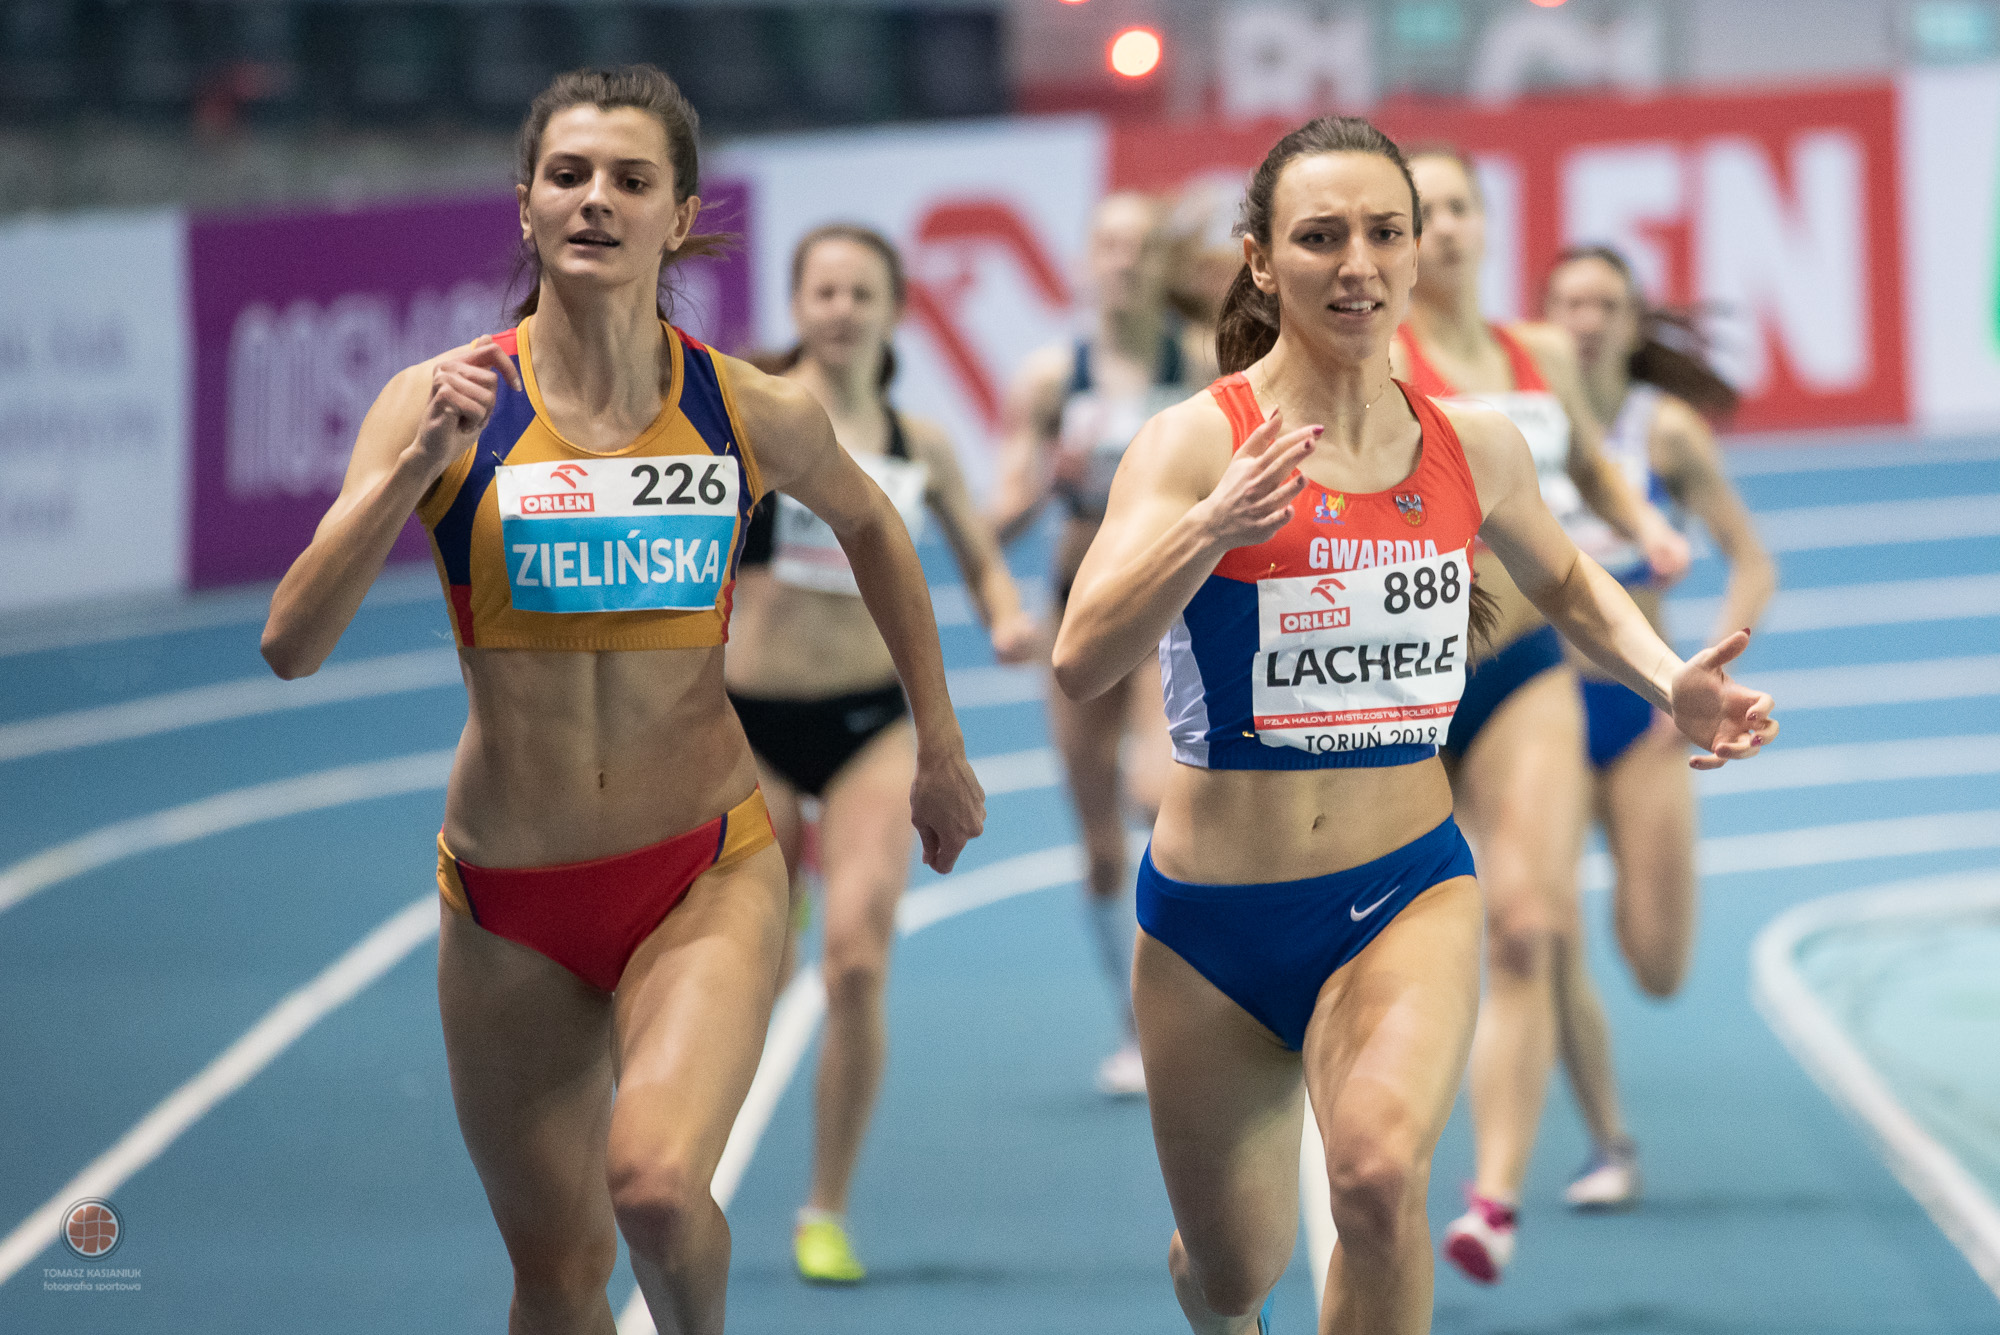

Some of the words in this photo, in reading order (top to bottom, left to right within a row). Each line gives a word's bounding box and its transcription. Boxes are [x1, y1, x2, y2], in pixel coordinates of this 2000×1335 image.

[630, 462, 727, 506] 226
[522, 494, 591, 513] ORLEN
[511, 529, 720, 588] ZIELIŃSKA
[1383, 560, 1461, 615] 888
[1282, 609, 1348, 632] ORLEN
[1266, 634, 1459, 688] LACHELE
[1263, 717, 1290, 726] PZLA
[1291, 715, 1333, 724] HALOWE
[1335, 710, 1401, 722] MISTRZOSTWA
[1402, 707, 1434, 717] POLSKI
[1304, 724, 1382, 752] TORUŃ
[1389, 726, 1438, 745] 2019
